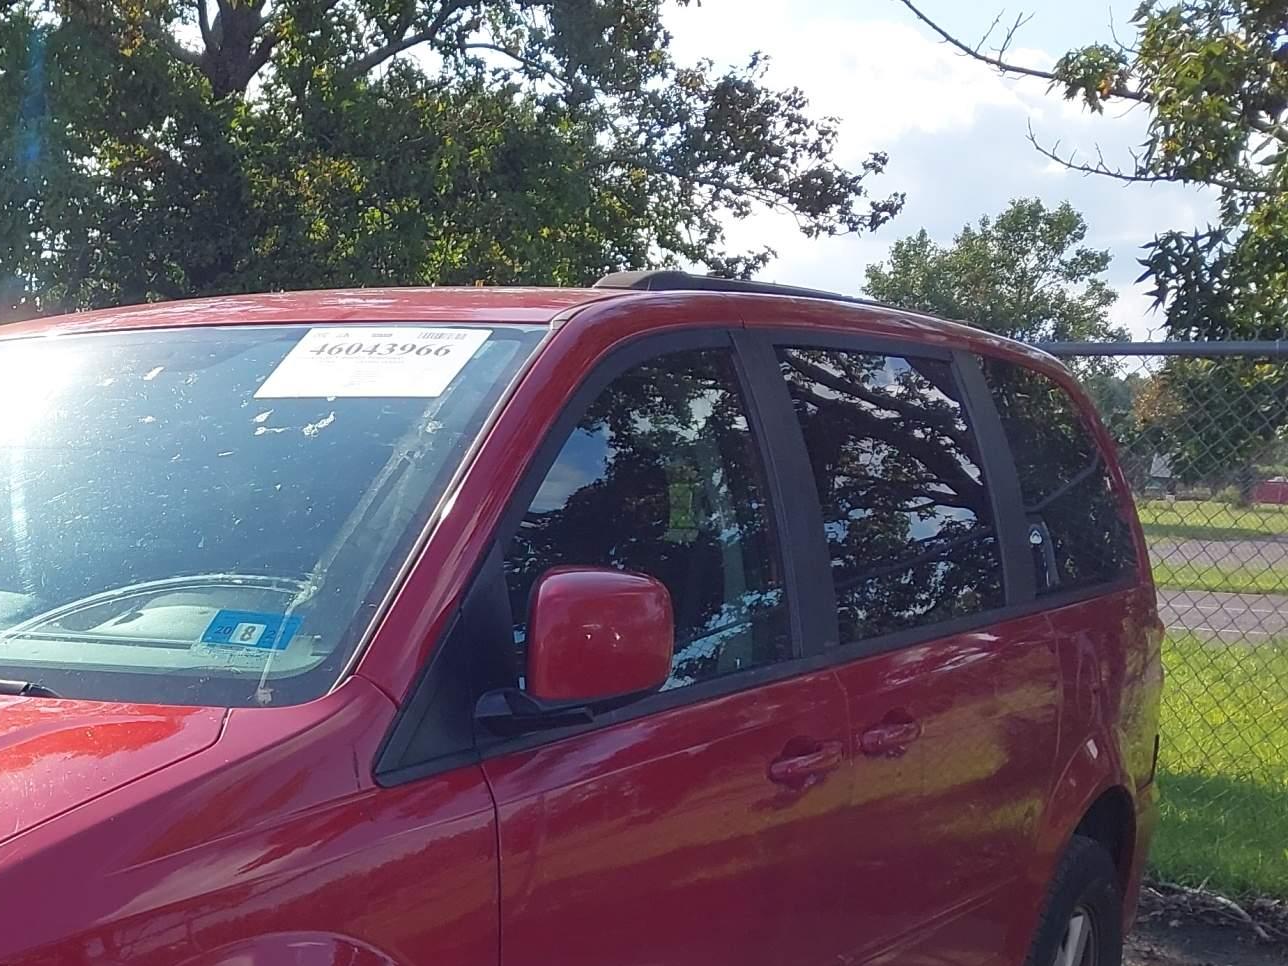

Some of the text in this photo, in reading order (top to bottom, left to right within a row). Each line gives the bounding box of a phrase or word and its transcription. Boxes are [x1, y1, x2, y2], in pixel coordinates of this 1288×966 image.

[309, 342, 455, 357] 46043966
[215, 625, 232, 635] 20
[239, 625, 256, 642] 8
